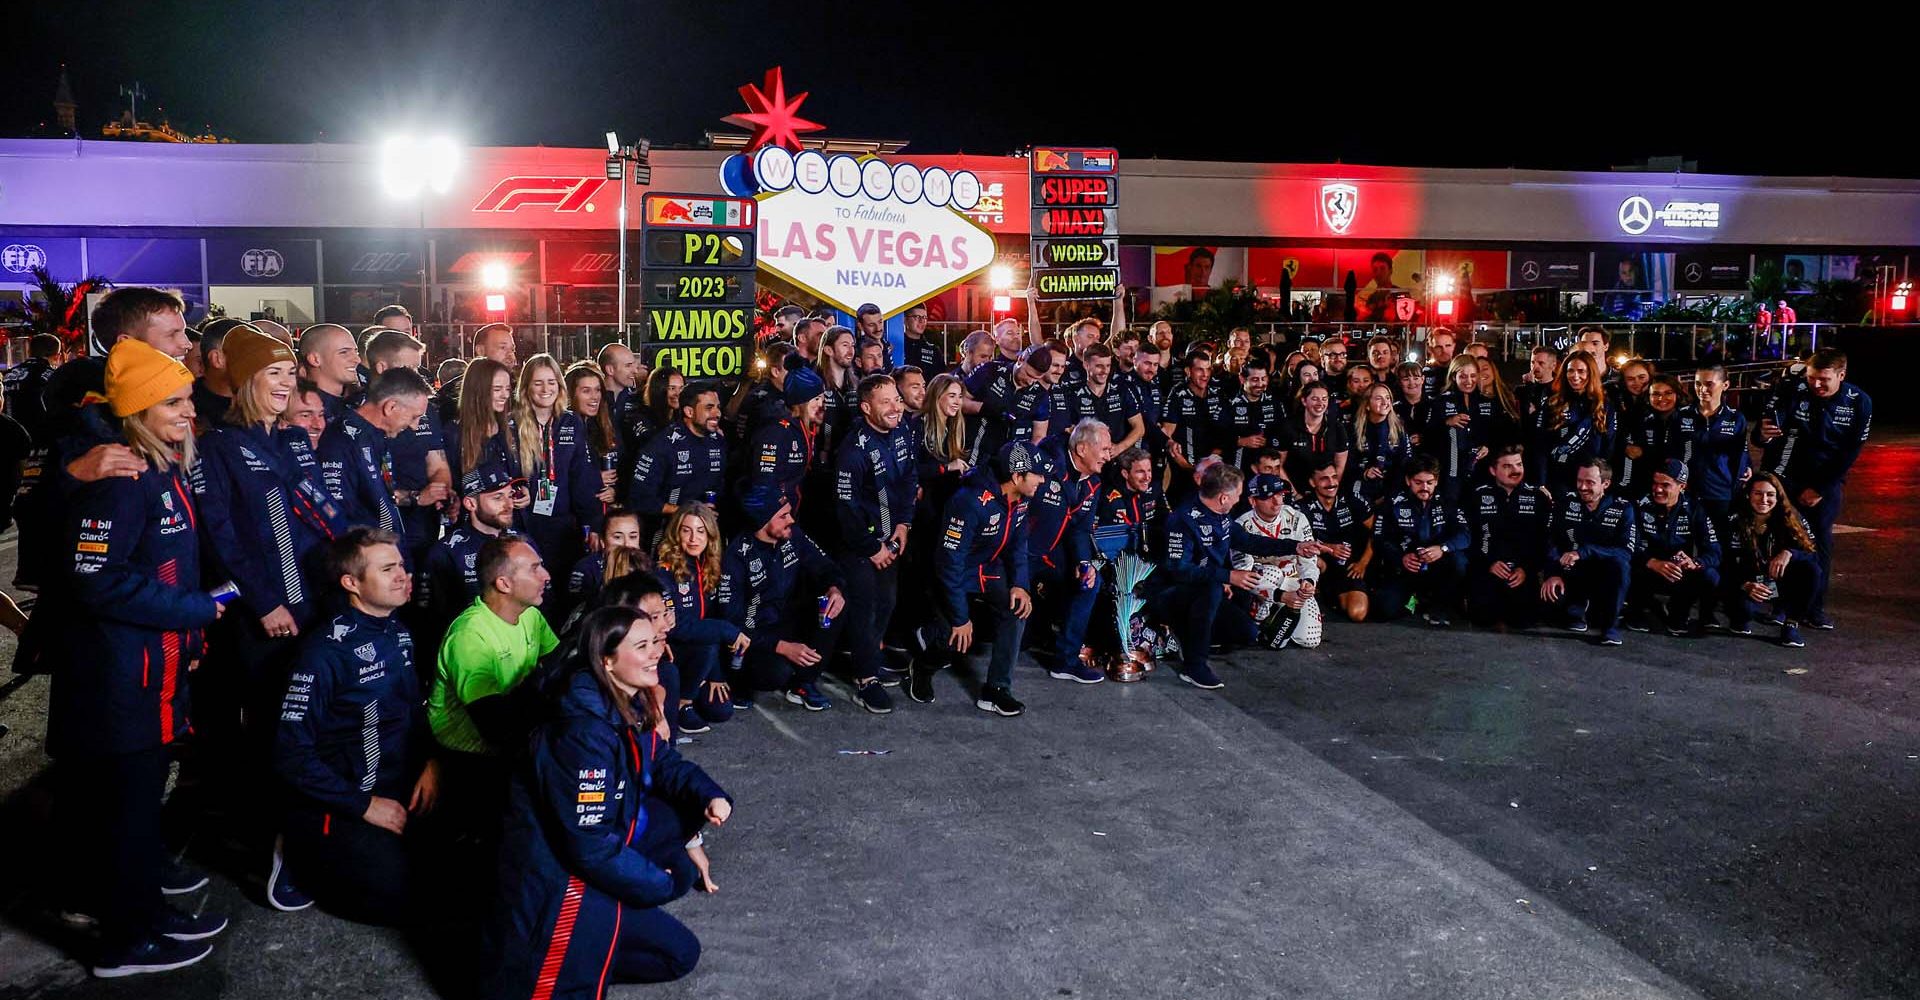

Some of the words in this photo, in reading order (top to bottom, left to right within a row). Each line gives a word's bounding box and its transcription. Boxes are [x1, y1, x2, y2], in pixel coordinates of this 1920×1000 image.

[766, 156, 971, 200] WELCOME
[1045, 177, 1107, 204] SUPER
[835, 207, 850, 219] TO
[854, 203, 906, 224] Fabulous
[1051, 208, 1103, 235] MAX!
[1655, 210, 1719, 221] PETRONAS
[684, 233, 721, 265] P2
[760, 218, 837, 262] LAS
[846, 226, 969, 270] VEGAS
[1051, 244, 1104, 262] WORLD
[679, 276, 725, 298] 2023
[836, 269, 907, 289] NEVADA
[1040, 274, 1115, 293] CHAMPION
[651, 308, 746, 341] VAMOS
[655, 346, 743, 378] CHECO!
[81, 518, 112, 530] Mobil
[79, 531, 108, 541] Claro
[75, 562, 102, 573] HRC
[1271, 617, 1293, 648] FERRARI
[356, 643, 374, 655] TAG
[292, 672, 315, 683] Mobil
[359, 663, 378, 676] Mobil
[359, 671, 386, 684] ORACLE
[579, 768, 607, 780] Mobil
[579, 780, 605, 791] Claro
[578, 813, 604, 826] HRC
